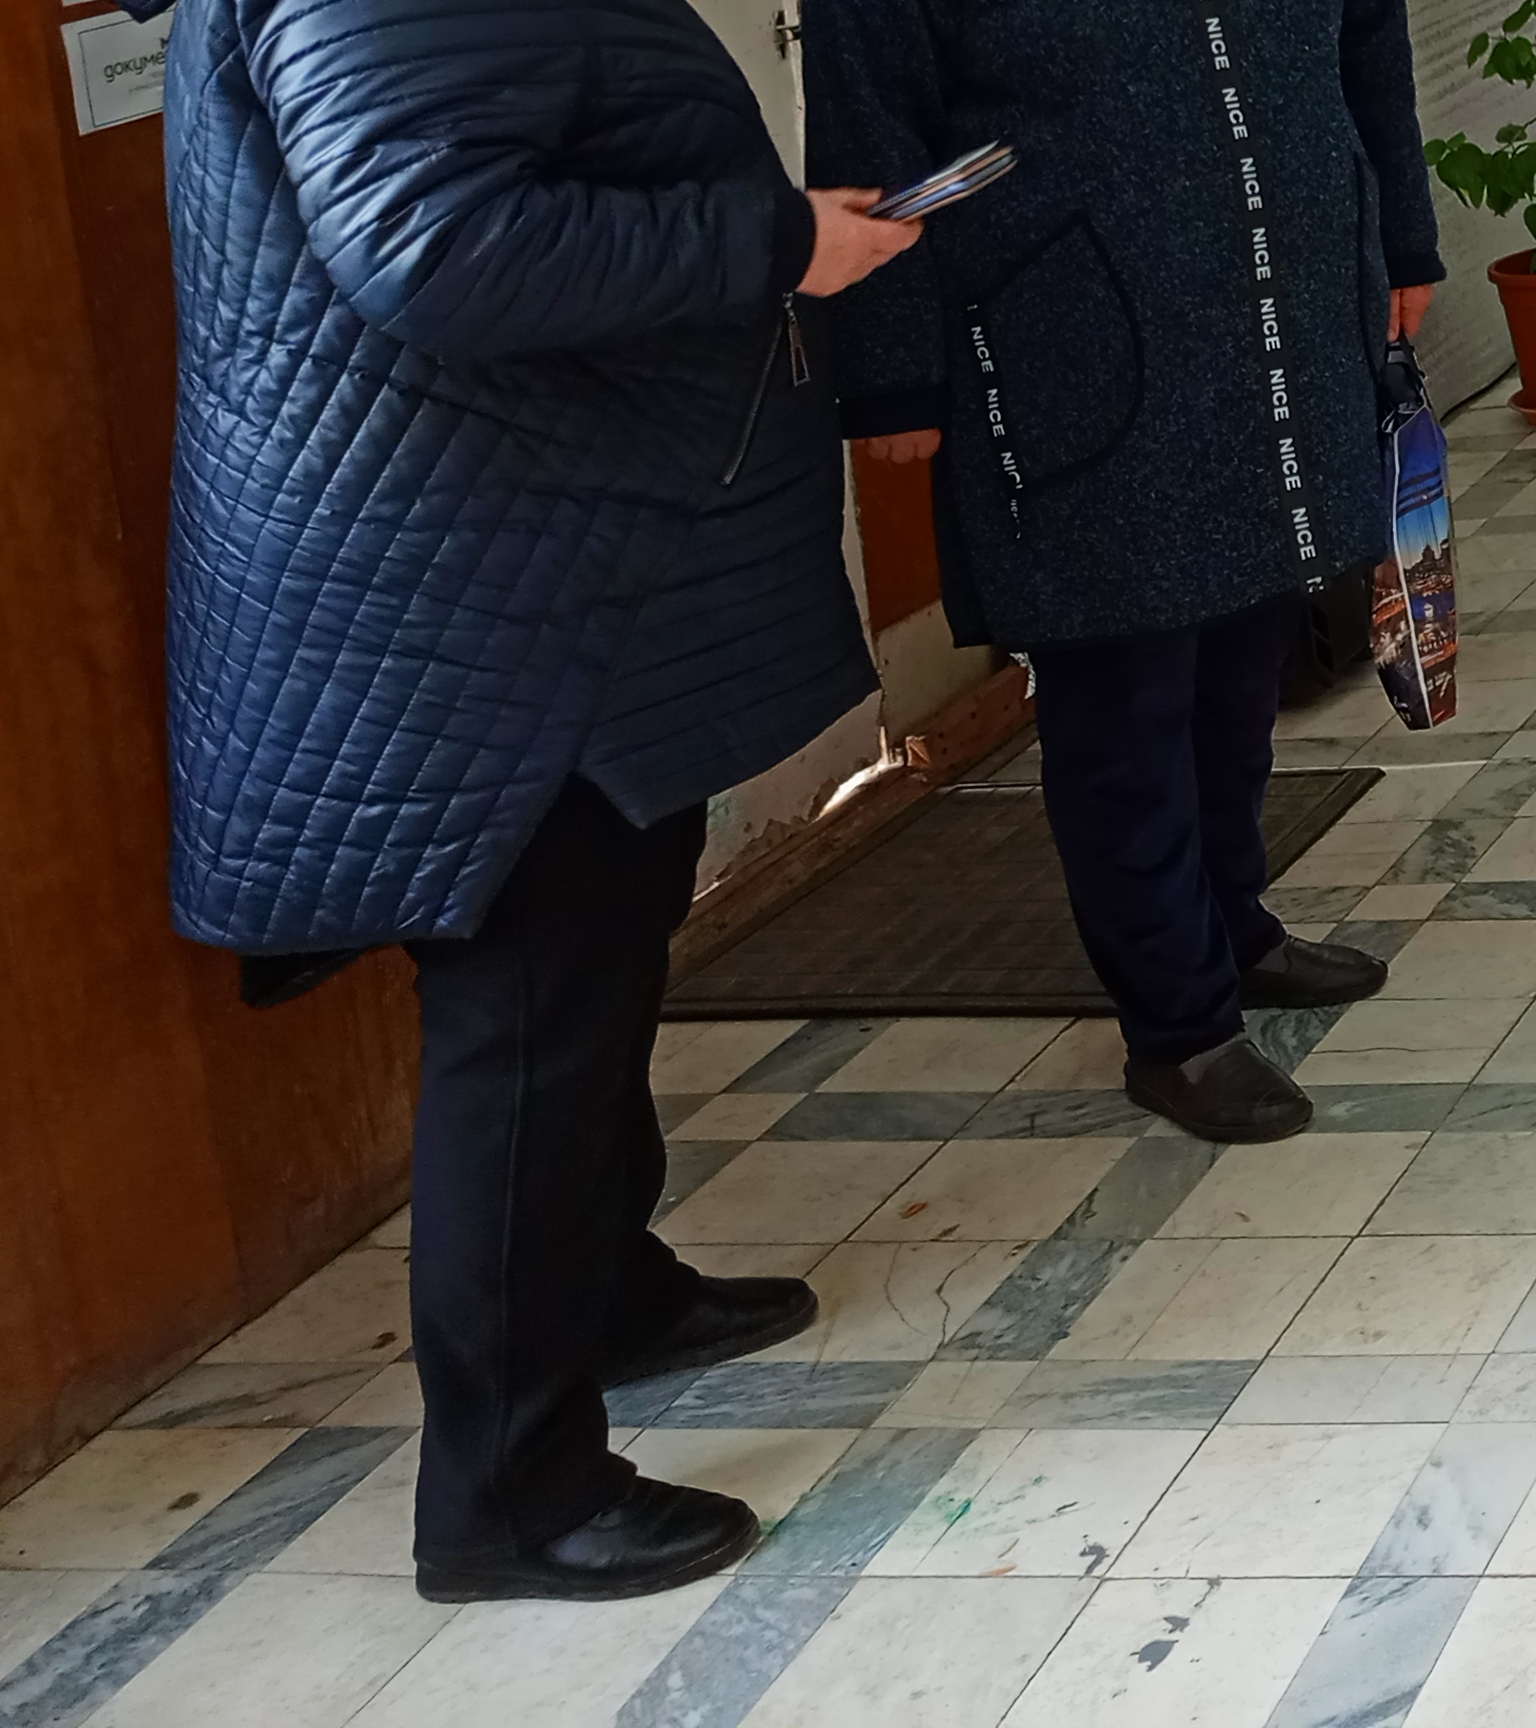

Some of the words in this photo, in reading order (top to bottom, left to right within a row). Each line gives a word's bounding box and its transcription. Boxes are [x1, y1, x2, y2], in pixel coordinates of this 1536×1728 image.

[103, 51, 166, 83] докуме
[1205, 17, 1230, 70] NICE
[1221, 87, 1249, 140] NICE
[1240, 157, 1263, 211] NICE
[1251, 227, 1271, 281] NICE
[1259, 297, 1281, 352] NICE
[971, 325, 994, 373] NICE
[987, 387, 1005, 438] NICE
[1269, 368, 1290, 422] NICE
[1278, 437, 1302, 491] NICE
[1291, 507, 1316, 561] NICE
